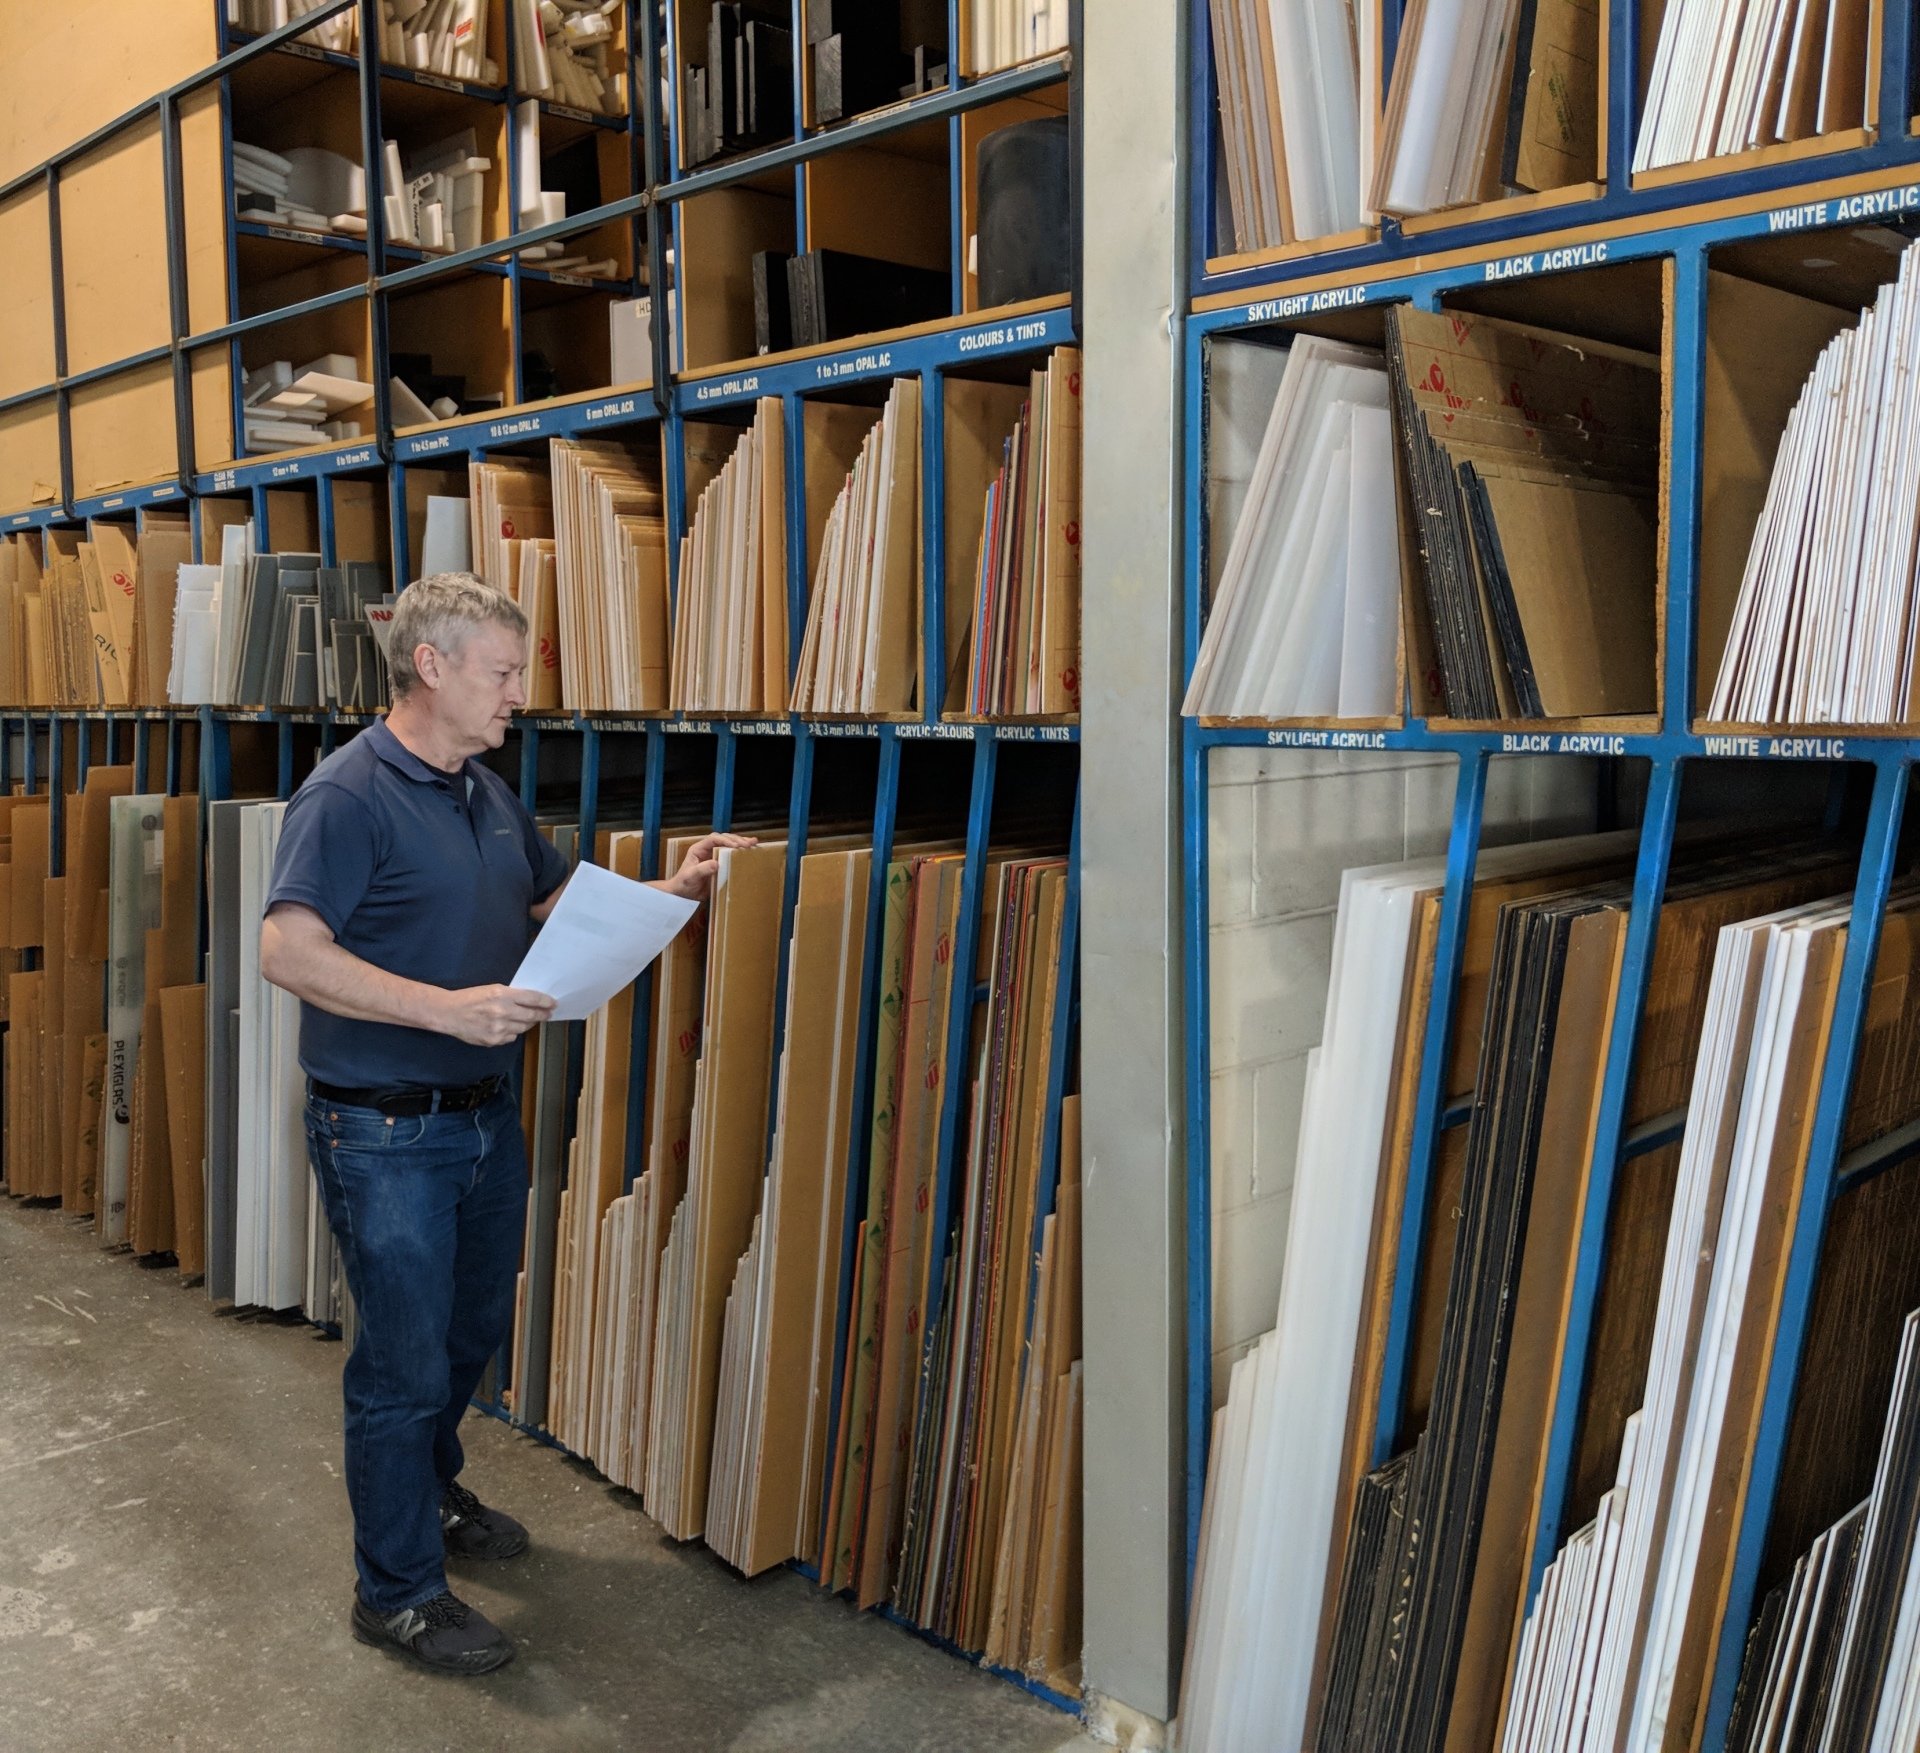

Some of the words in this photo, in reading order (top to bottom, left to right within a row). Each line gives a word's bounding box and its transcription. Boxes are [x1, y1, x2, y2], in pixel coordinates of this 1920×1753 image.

[1769, 203, 1826, 232] WHITE
[1836, 186, 1919, 221] ACRYLIC
[1485, 254, 1533, 282] BLACK
[1541, 243, 1607, 272] ACRYLIC
[1248, 298, 1308, 322] SKYLIGHT
[1311, 286, 1366, 311] ACRYLIC
[960, 329, 1004, 351] COLOURS
[1006, 328, 1014, 342] &
[1016, 321, 1046, 341] TINTS
[816, 365, 821, 379] 1
[823, 364, 831, 378] to
[833, 362, 839, 376] 3
[840, 363, 854, 375] mm
[856, 355, 877, 372] OPAL
[879, 352, 891, 368] AC
[697, 386, 708, 400] 4.5
[709, 387, 722, 398] mm
[723, 380, 742, 395] OPAL
[743, 376, 759, 392] ACR
[586, 408, 591, 420] 6
[603, 403, 620, 417] OPAL
[621, 400, 635, 414] ACR
[518, 420, 532, 432] OPAL
[563, 719, 575, 730] PVC
[622, 720, 637, 732] OPAL
[637, 720, 646, 732] AC
[661, 721, 666, 732] 6
[666, 724, 679, 733] mm
[679, 721, 696, 733] OPAL
[697, 721, 712, 733] ACR
[730, 722, 741, 734] 4.5
[742, 725, 755, 734] mm
[756, 723, 775, 735] OPAL
[776, 723, 792, 735] ACR
[823, 723, 829, 736] 3
[829, 726, 843, 736] mm
[845, 724, 864, 736] OPAL
[867, 724, 879, 737] AC
[895, 725, 930, 738] ACRYLIC
[933, 725, 975, 740] COLOURS
[995, 727, 1035, 740] ACRYLIC
[1040, 727, 1070, 741] TINTS
[1267, 731, 1327, 747] SKYLIGHT
[1332, 733, 1385, 749] ACRYLIC
[1503, 735, 1551, 753] BLACK
[1558, 735, 1624, 755] ACRYLIC
[1704, 737, 1759, 757] WHITE
[1768, 738, 1845, 759] ACRYLIC
[112, 1040, 125, 1106] PLEXIGLAS
